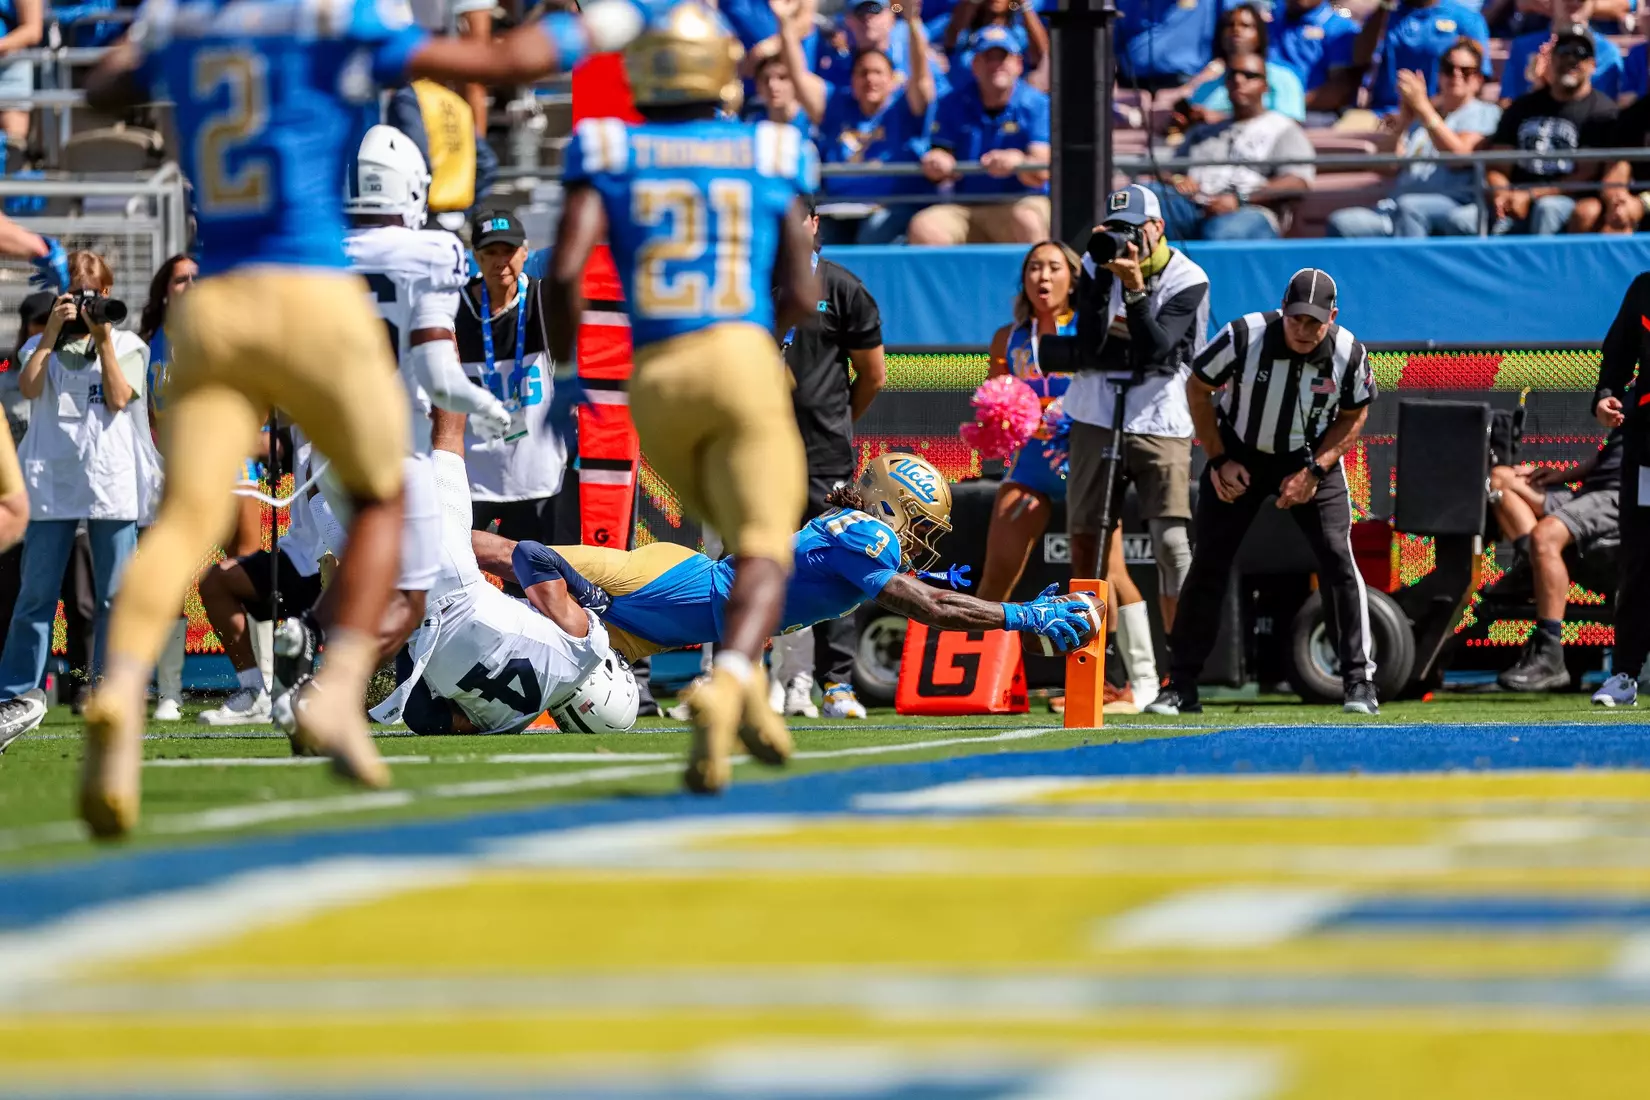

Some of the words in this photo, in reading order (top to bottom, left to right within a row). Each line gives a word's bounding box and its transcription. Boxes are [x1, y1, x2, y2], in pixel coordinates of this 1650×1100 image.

[191, 48, 270, 215] 2
[631, 179, 755, 318] 21
[594, 528, 609, 545] G
[865, 530, 890, 559] 3
[455, 657, 542, 716] 4
[917, 626, 985, 697] G
